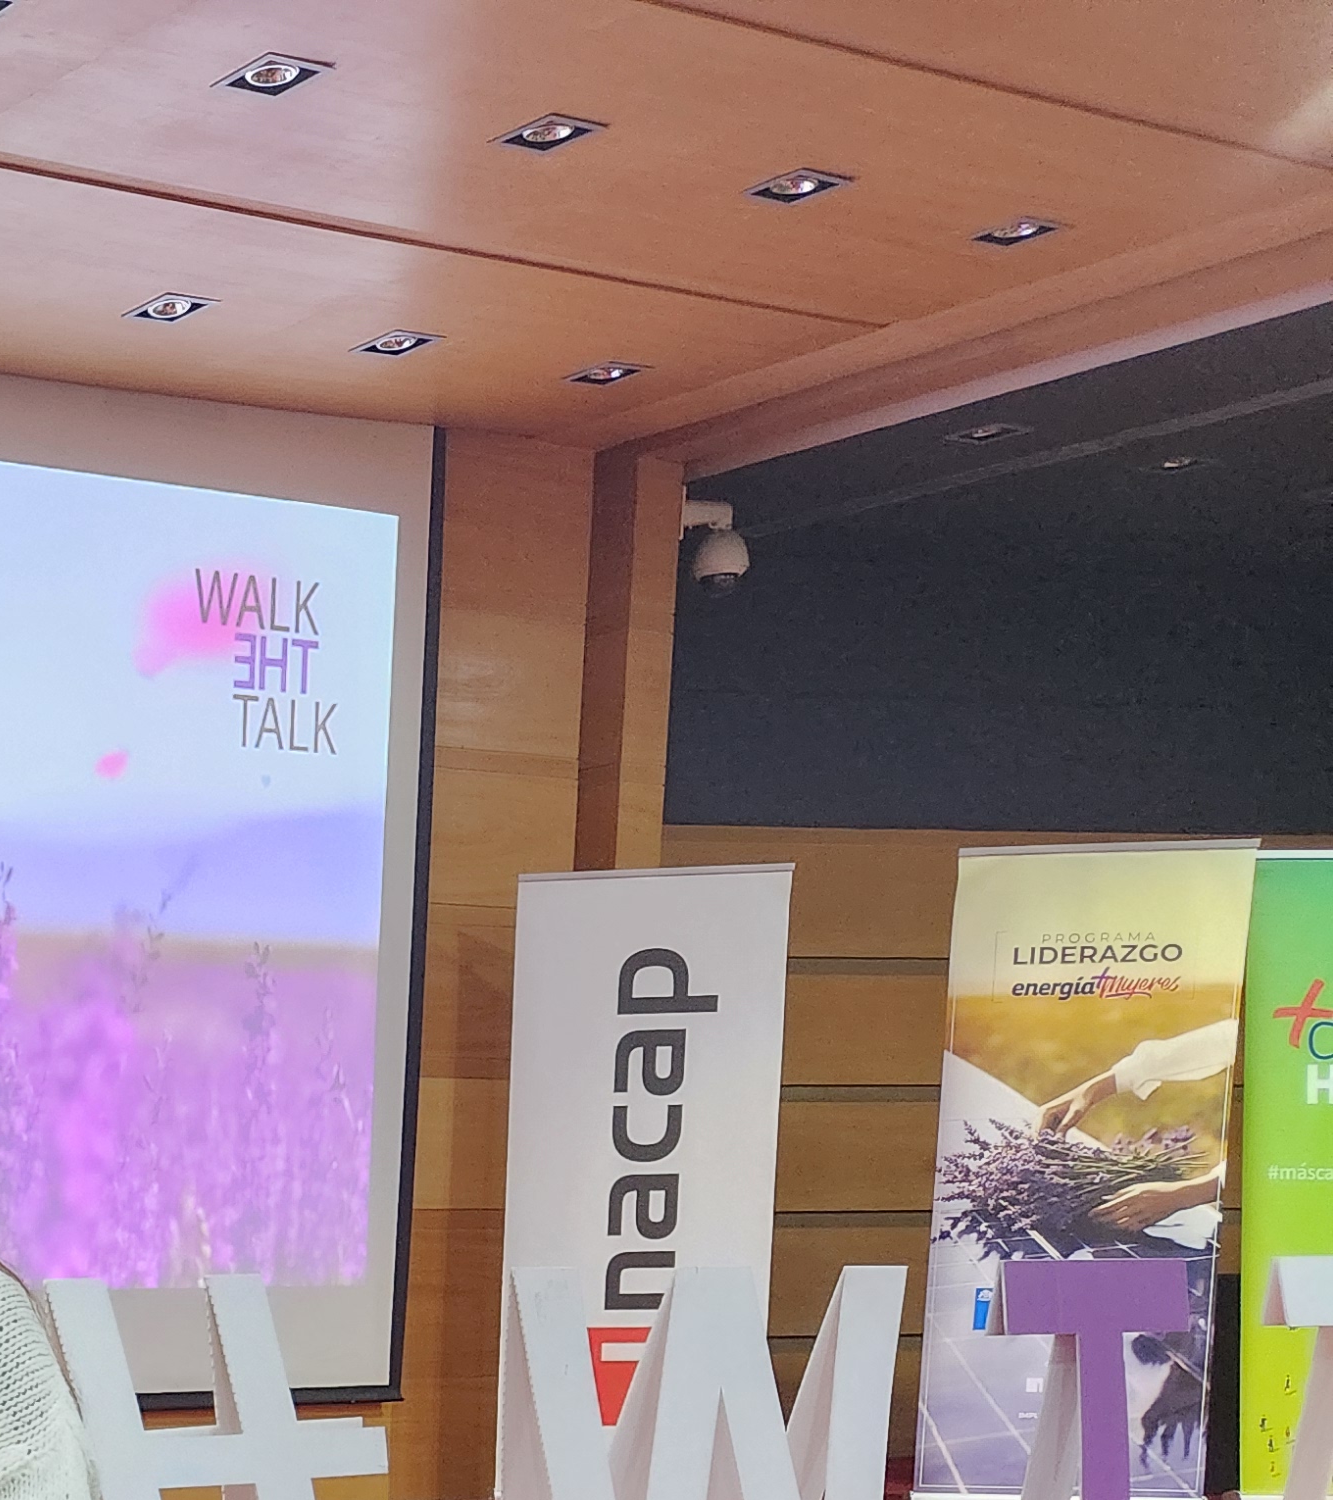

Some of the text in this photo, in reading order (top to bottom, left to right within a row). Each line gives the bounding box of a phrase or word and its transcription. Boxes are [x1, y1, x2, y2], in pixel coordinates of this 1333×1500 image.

[195, 567, 320, 636] WALK
[232, 693, 338, 755] TALK
[1012, 943, 1183, 966] LIDERAZGO
[1041, 931, 1156, 944] PROGRAMA
